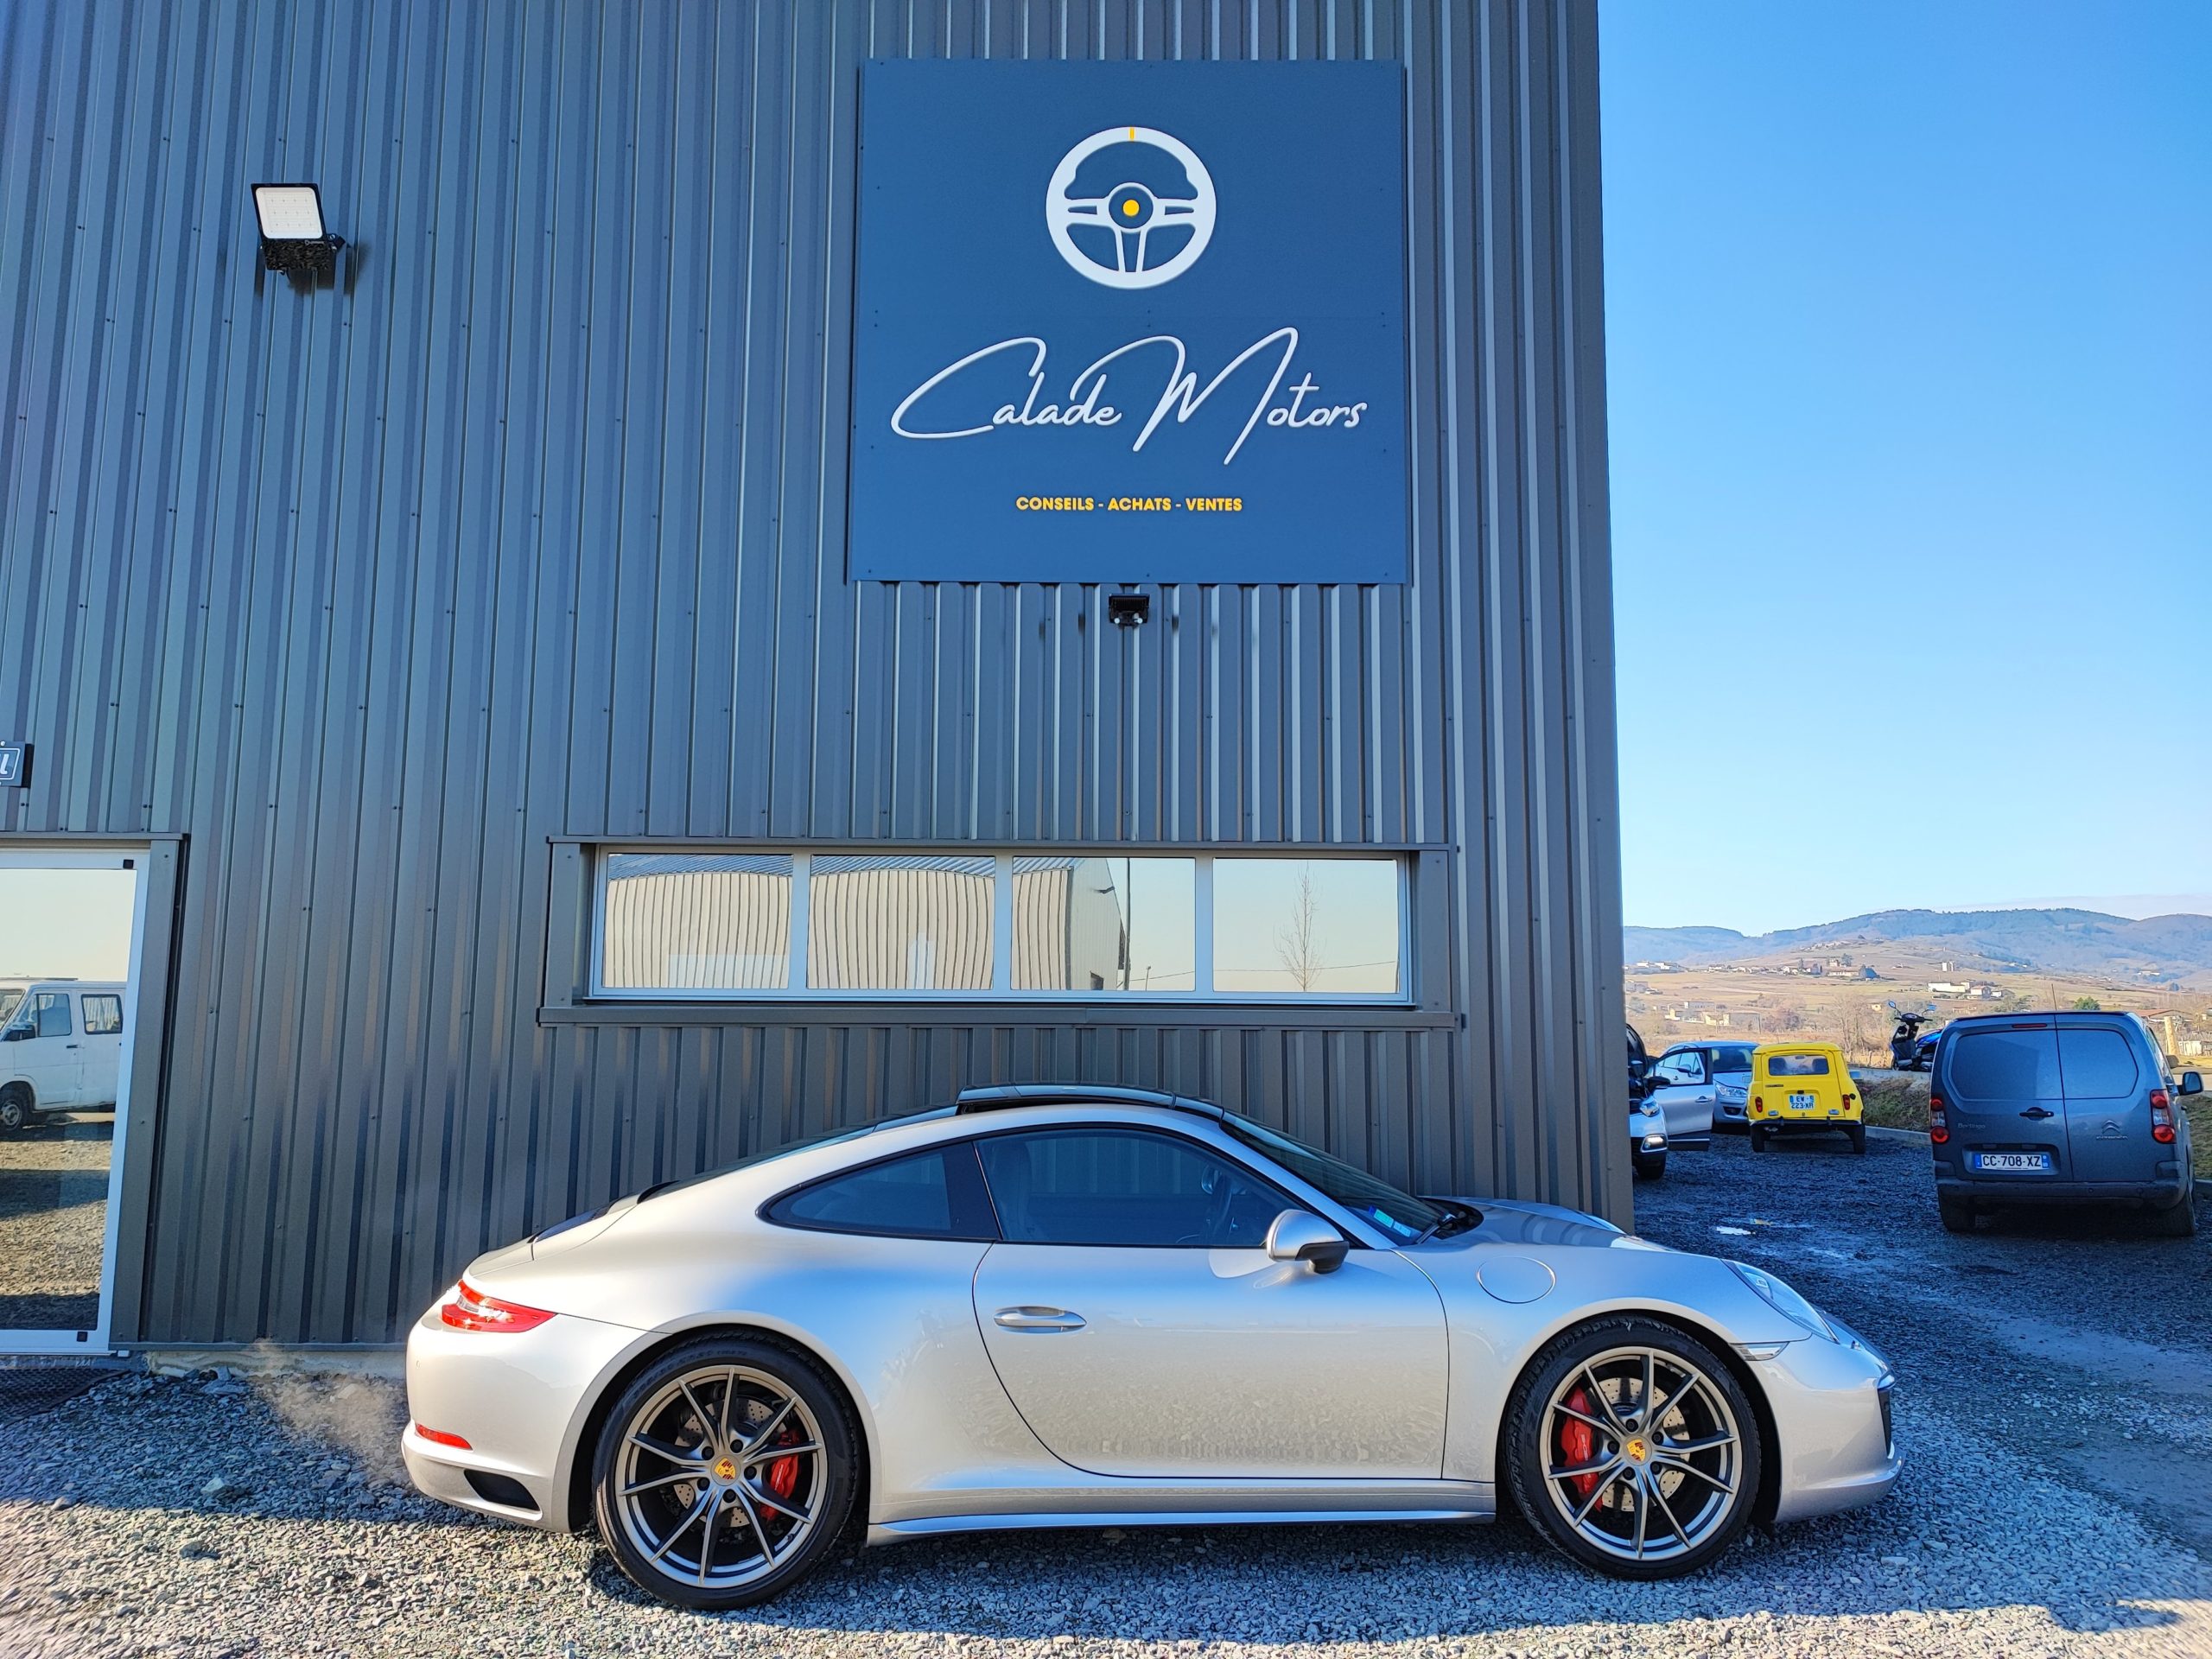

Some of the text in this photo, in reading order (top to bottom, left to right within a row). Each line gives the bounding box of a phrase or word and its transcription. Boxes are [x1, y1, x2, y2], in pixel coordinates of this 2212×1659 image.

[891, 327, 1368, 465] Calade Motors
[1015, 496, 1095, 512] CONSEILS
[1107, 497, 1172, 512] ACHATS
[1185, 498, 1243, 512] VENTES
[1982, 1155, 2041, 1167] CC-708-XZ
